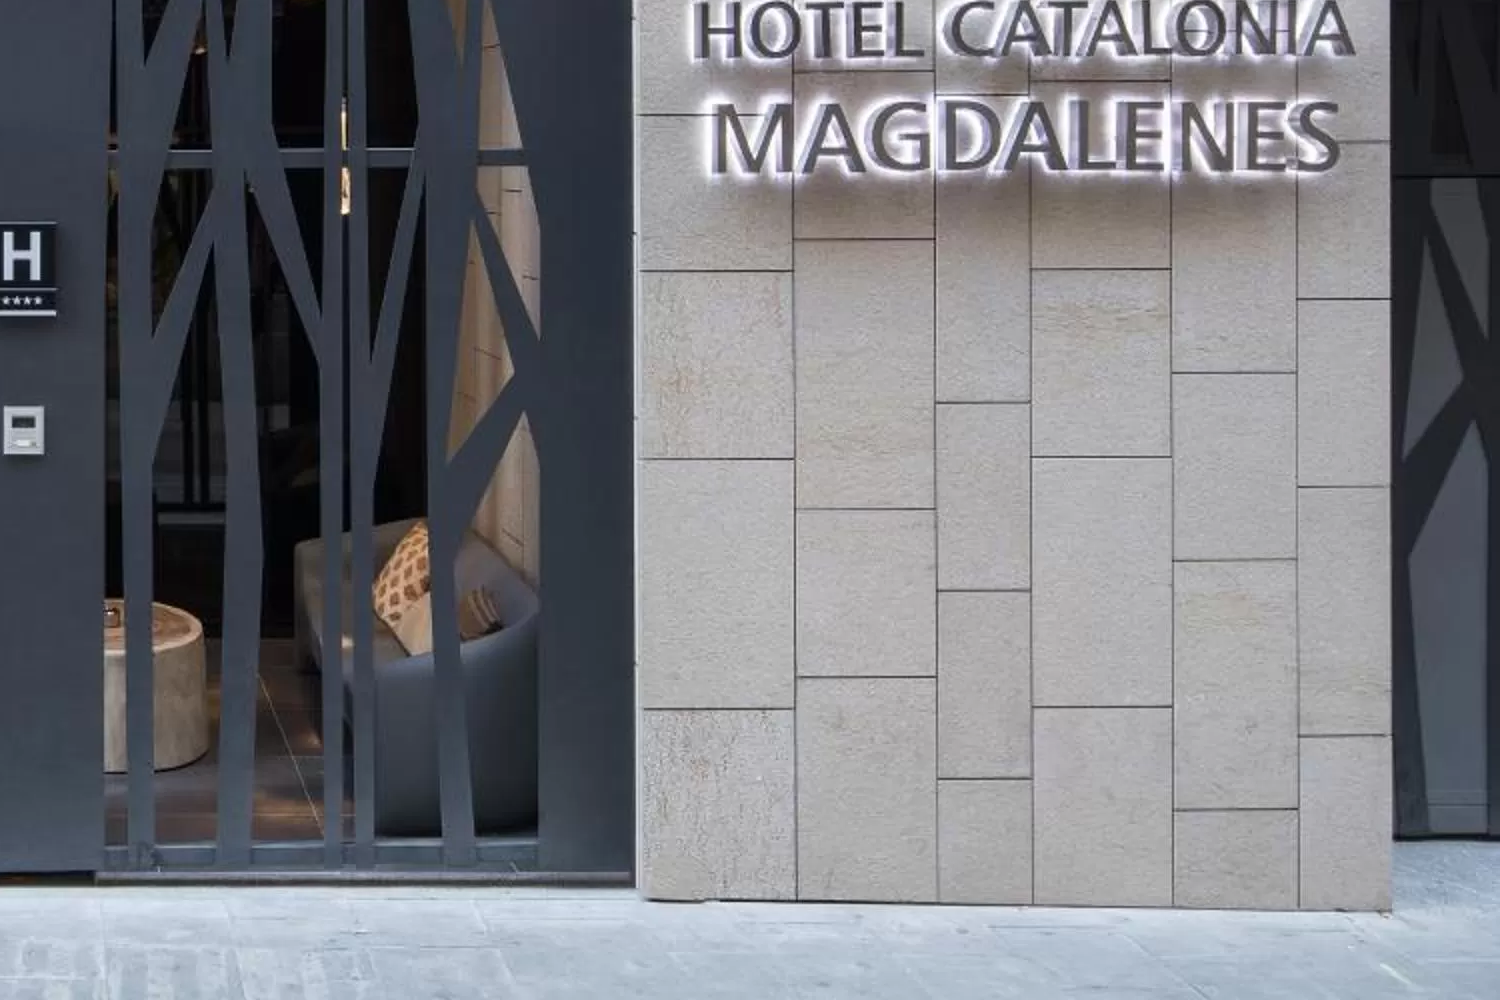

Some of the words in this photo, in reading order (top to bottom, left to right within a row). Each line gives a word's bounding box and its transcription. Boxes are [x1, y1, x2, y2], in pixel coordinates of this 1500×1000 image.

[694, 0, 926, 58] HOTEL
[709, 100, 1343, 173] MAGDALENES
[3, 231, 41, 281] H
